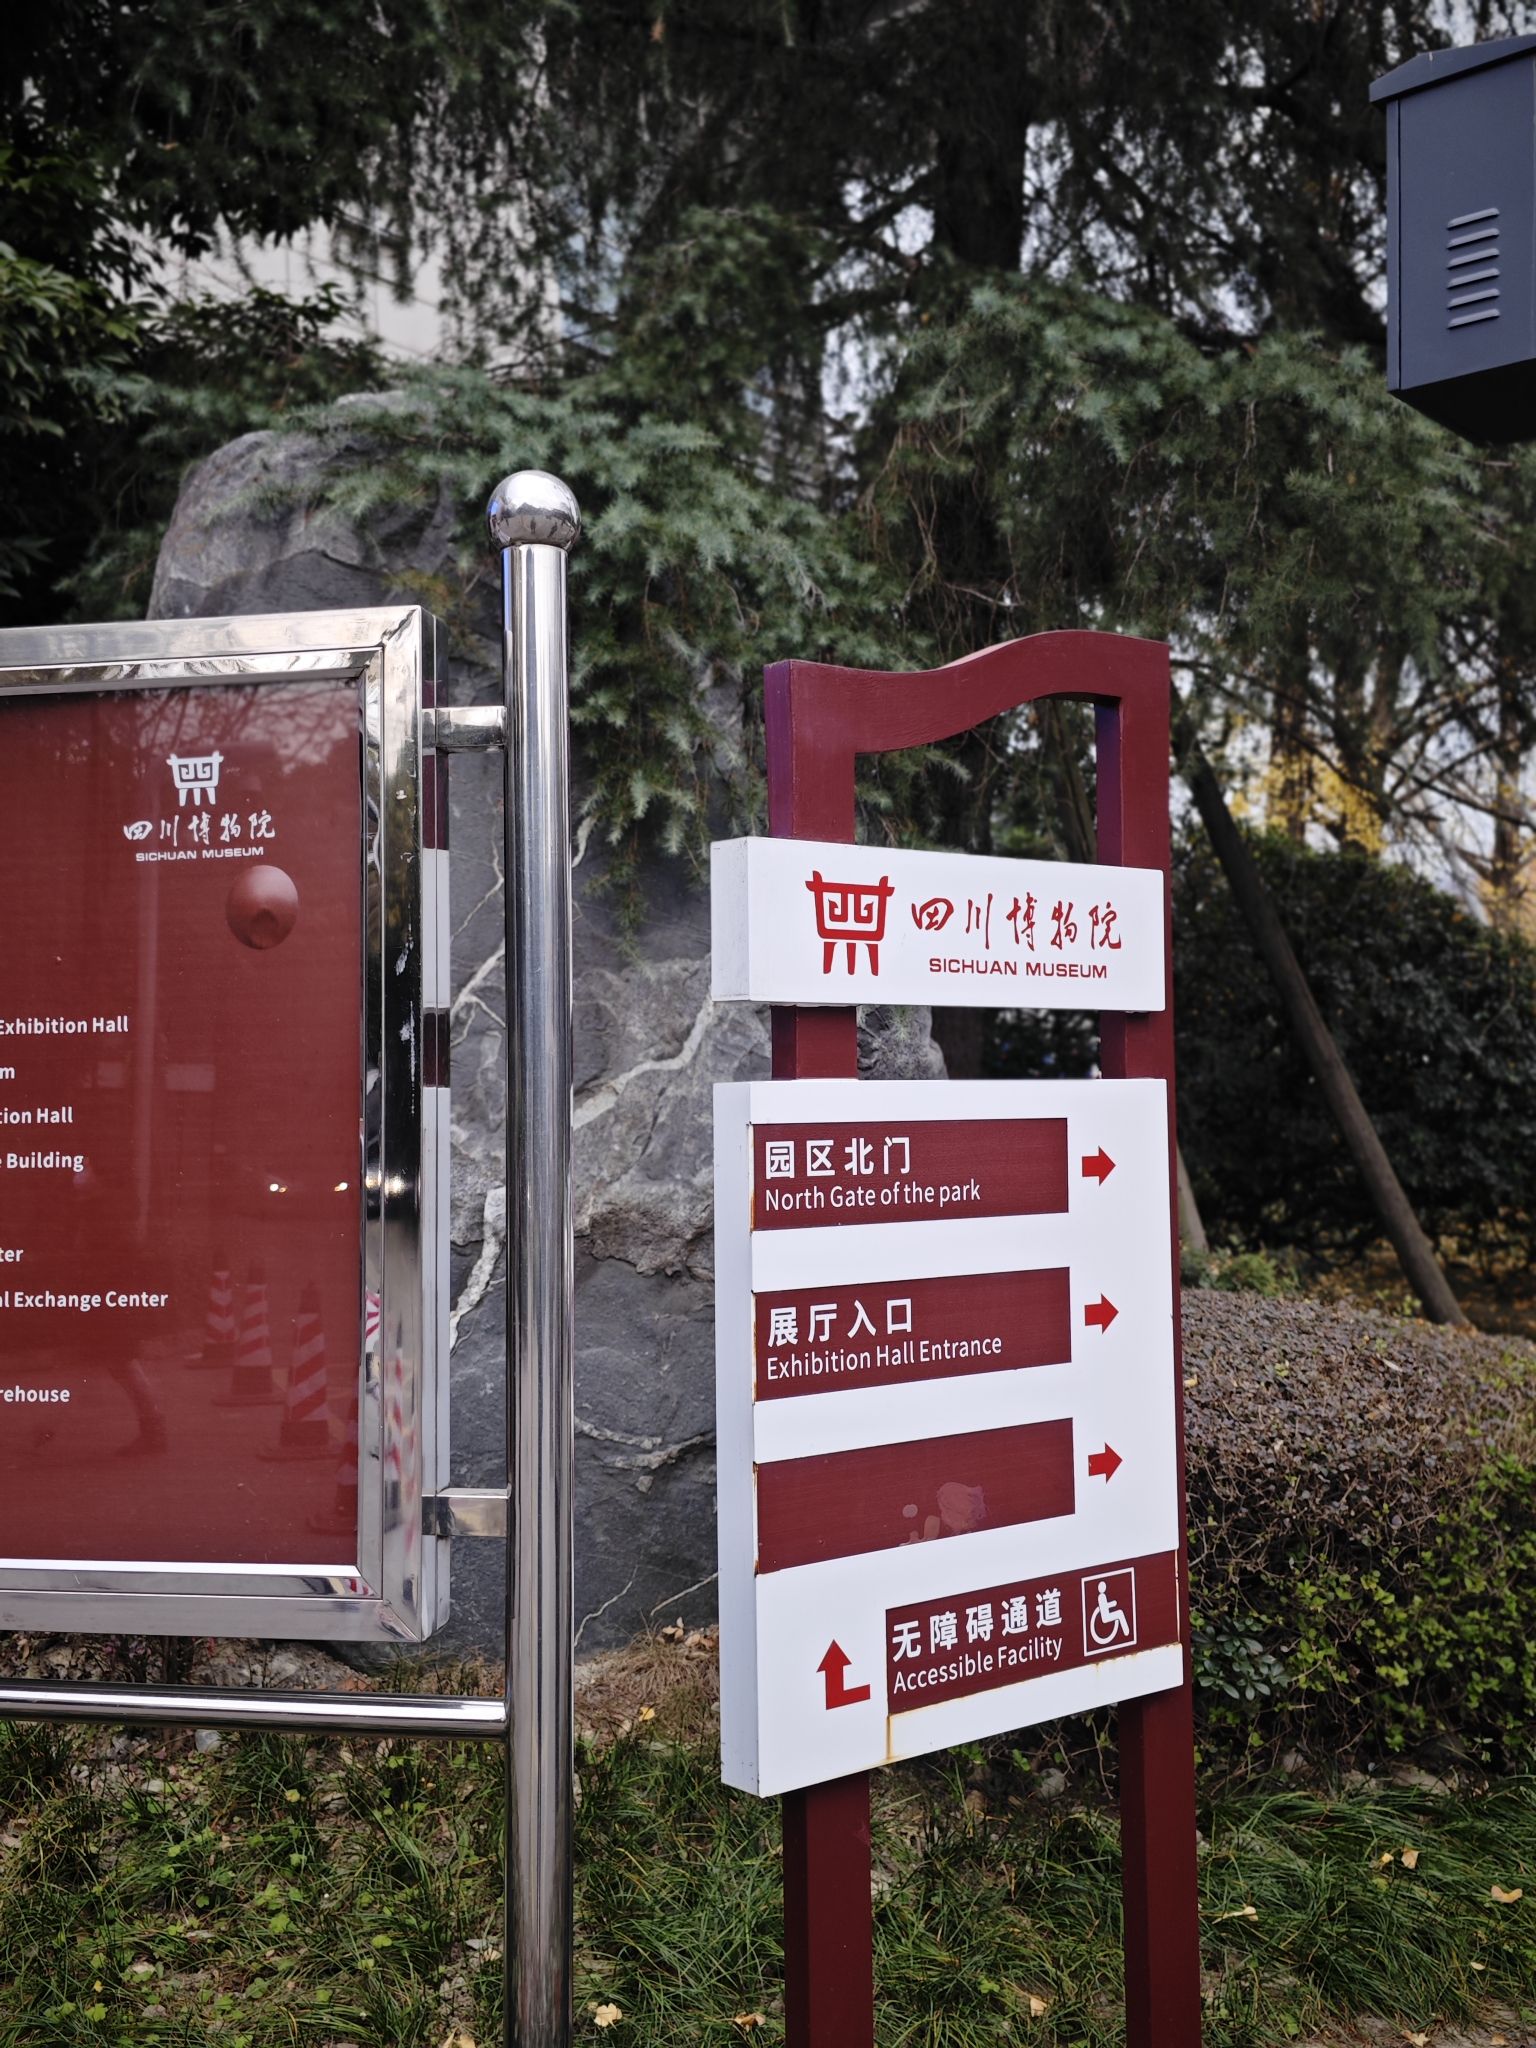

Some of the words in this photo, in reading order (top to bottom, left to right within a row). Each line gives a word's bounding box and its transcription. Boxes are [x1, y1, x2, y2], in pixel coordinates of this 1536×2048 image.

[123, 809, 276, 847] 四川博物院
[135, 850, 197, 862] SICHUAN
[202, 846, 264, 860] MUSEUM
[911, 891, 1122, 952] 四川博物院
[929, 958, 1017, 976] SICHUAN
[1025, 962, 1107, 979] MUSEUM
[92, 1015, 129, 1033] Hall
[36, 1106, 74, 1124] Hall
[6, 1151, 84, 1173] Building
[765, 1136, 911, 1179] 园区北门
[765, 1185, 825, 1211] North
[830, 1185, 876, 1208] Gate
[880, 1181, 901, 1205] of
[903, 1180, 935, 1204] the
[939, 1178, 981, 1207] park
[14, 1290, 102, 1312] Exchange
[105, 1290, 169, 1308] Center
[767, 1298, 913, 1347] 展厅入口
[767, 1347, 871, 1380] Exhibition
[876, 1340, 915, 1367] Hall
[919, 1336, 1002, 1362] Entrance
[892, 1587, 1063, 1663] 无障碍通道
[893, 1649, 994, 1694] Accessible
[997, 1635, 1063, 1669] Facility
